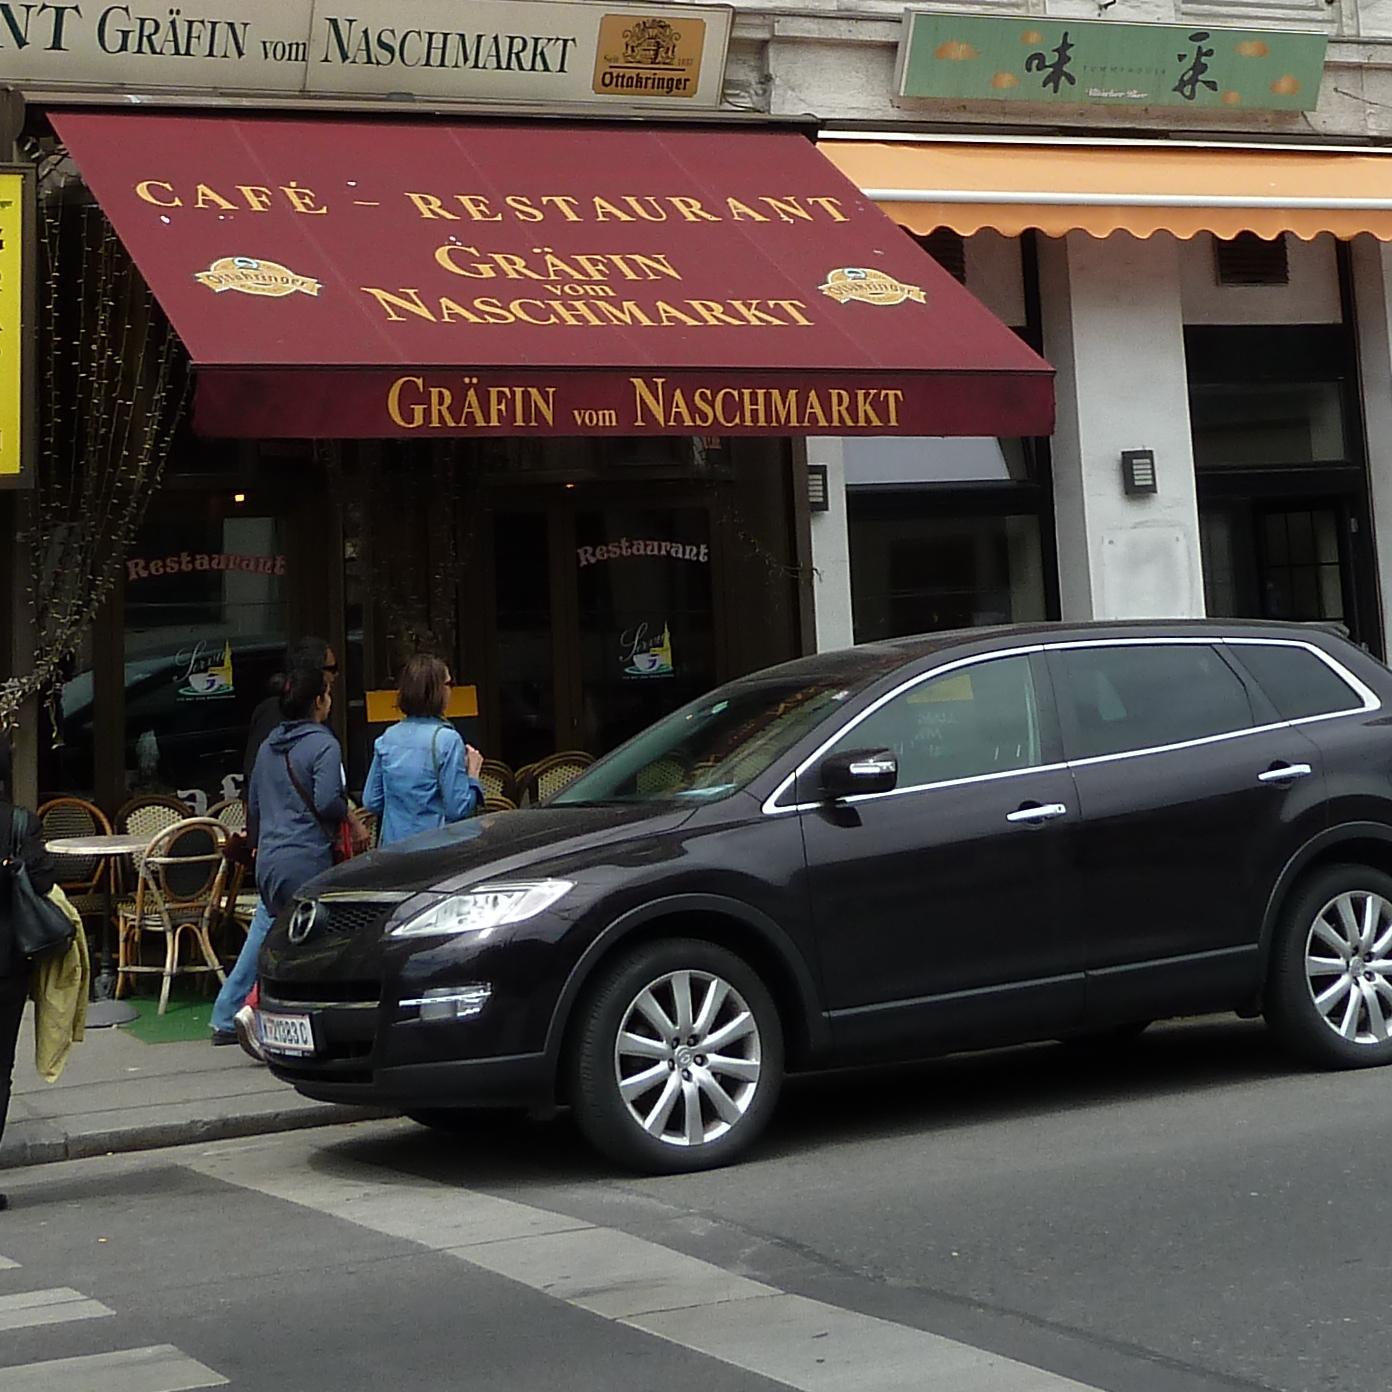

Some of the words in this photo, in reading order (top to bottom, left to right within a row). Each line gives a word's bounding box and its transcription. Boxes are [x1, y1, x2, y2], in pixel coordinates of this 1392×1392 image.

[97, 5, 250, 59] GRÄFIN
[260, 38, 307, 63] vom
[321, 16, 577, 73] NASCHMARKT
[601, 71, 690, 95] Ottakringer
[405, 192, 851, 224] RESTAURANT
[435, 244, 682, 281] GRÄFIN
[544, 282, 617, 298] vom
[361, 286, 816, 327] NASCHMARKT
[387, 376, 556, 428] GRÄFIN
[573, 405, 618, 427] vom
[630, 377, 904, 428] NASCHMARKT
[126, 552, 290, 582] Restaurant
[577, 537, 709, 568] Restaurant
